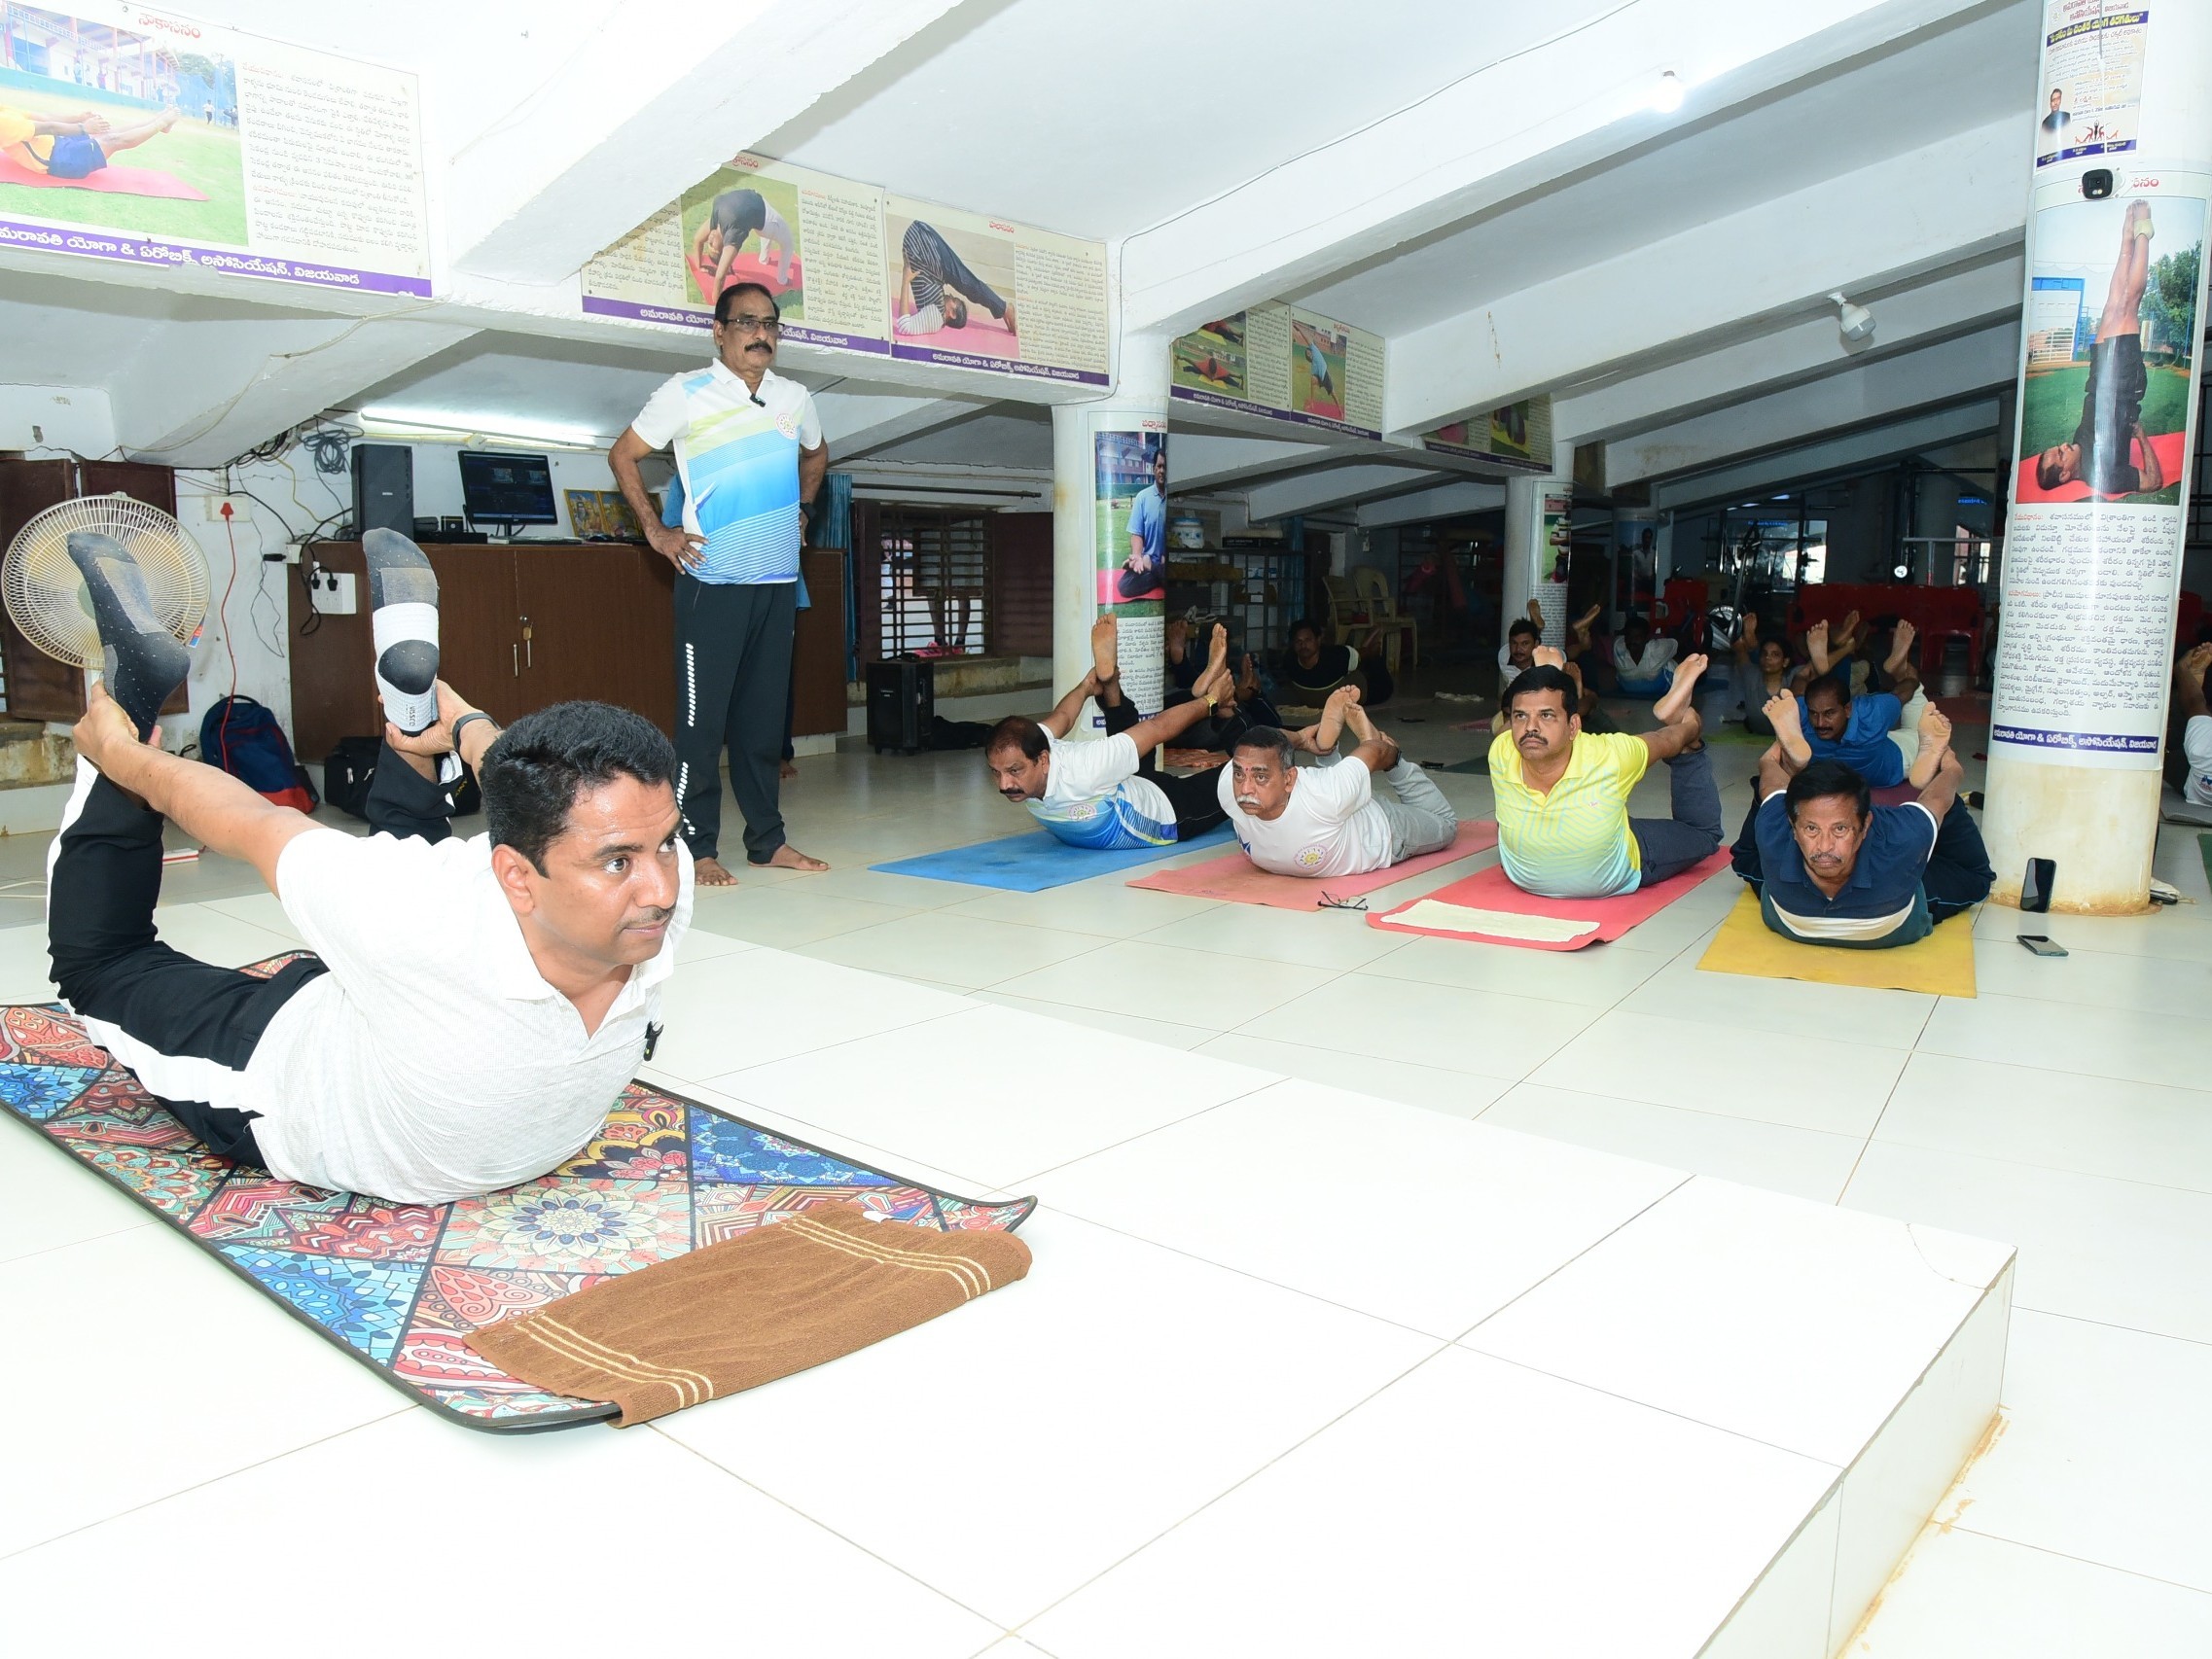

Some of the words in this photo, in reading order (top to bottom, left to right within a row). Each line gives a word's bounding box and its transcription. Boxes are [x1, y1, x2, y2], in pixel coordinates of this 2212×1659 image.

[67, 238, 117, 251] యోగా
[121, 245, 135, 255] &
[295, 267, 359, 283] విజయవాడ
[2101, 513, 2135, 522] విశ్రాంతిగా
[2037, 733, 2044, 742] &
